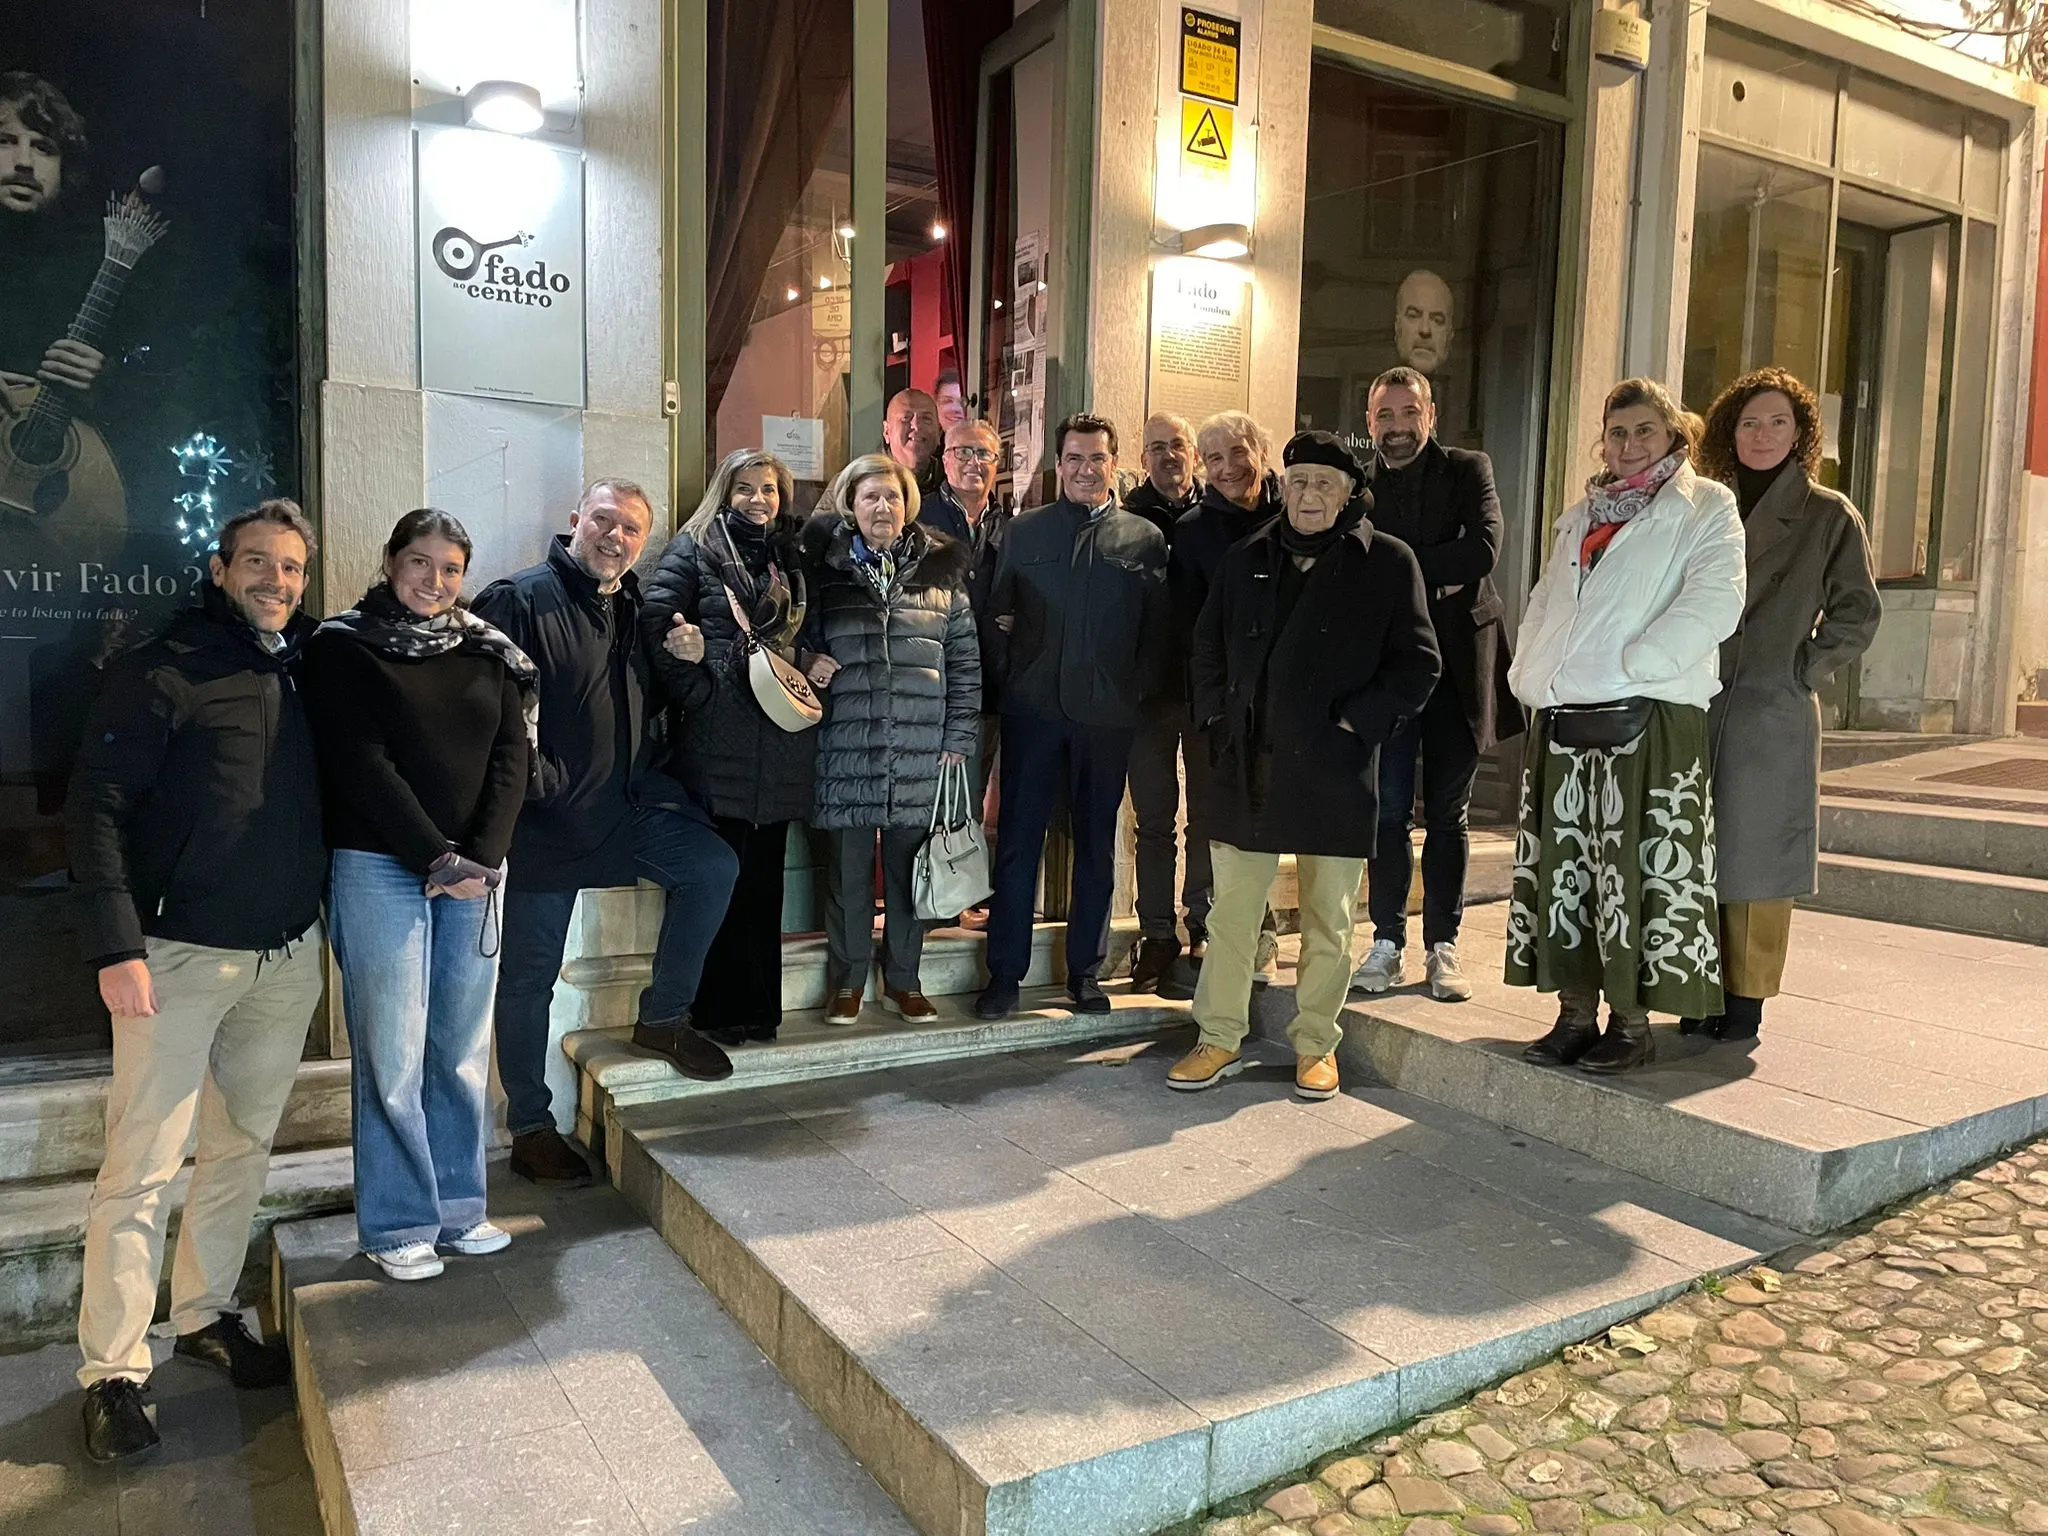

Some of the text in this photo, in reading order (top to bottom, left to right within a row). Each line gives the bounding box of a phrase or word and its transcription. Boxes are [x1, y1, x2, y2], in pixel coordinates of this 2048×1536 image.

[1197, 18, 1235, 36] PROSEGUR
[484, 253, 571, 293] fado
[453, 281, 553, 308] ao centro
[1177, 278, 1217, 300] ado
[2, 562, 204, 598] vir Fado?
[11, 607, 27, 618] to
[31, 606, 72, 620] listen
[76, 608, 92, 620] to
[96, 608, 139, 621] fado?
